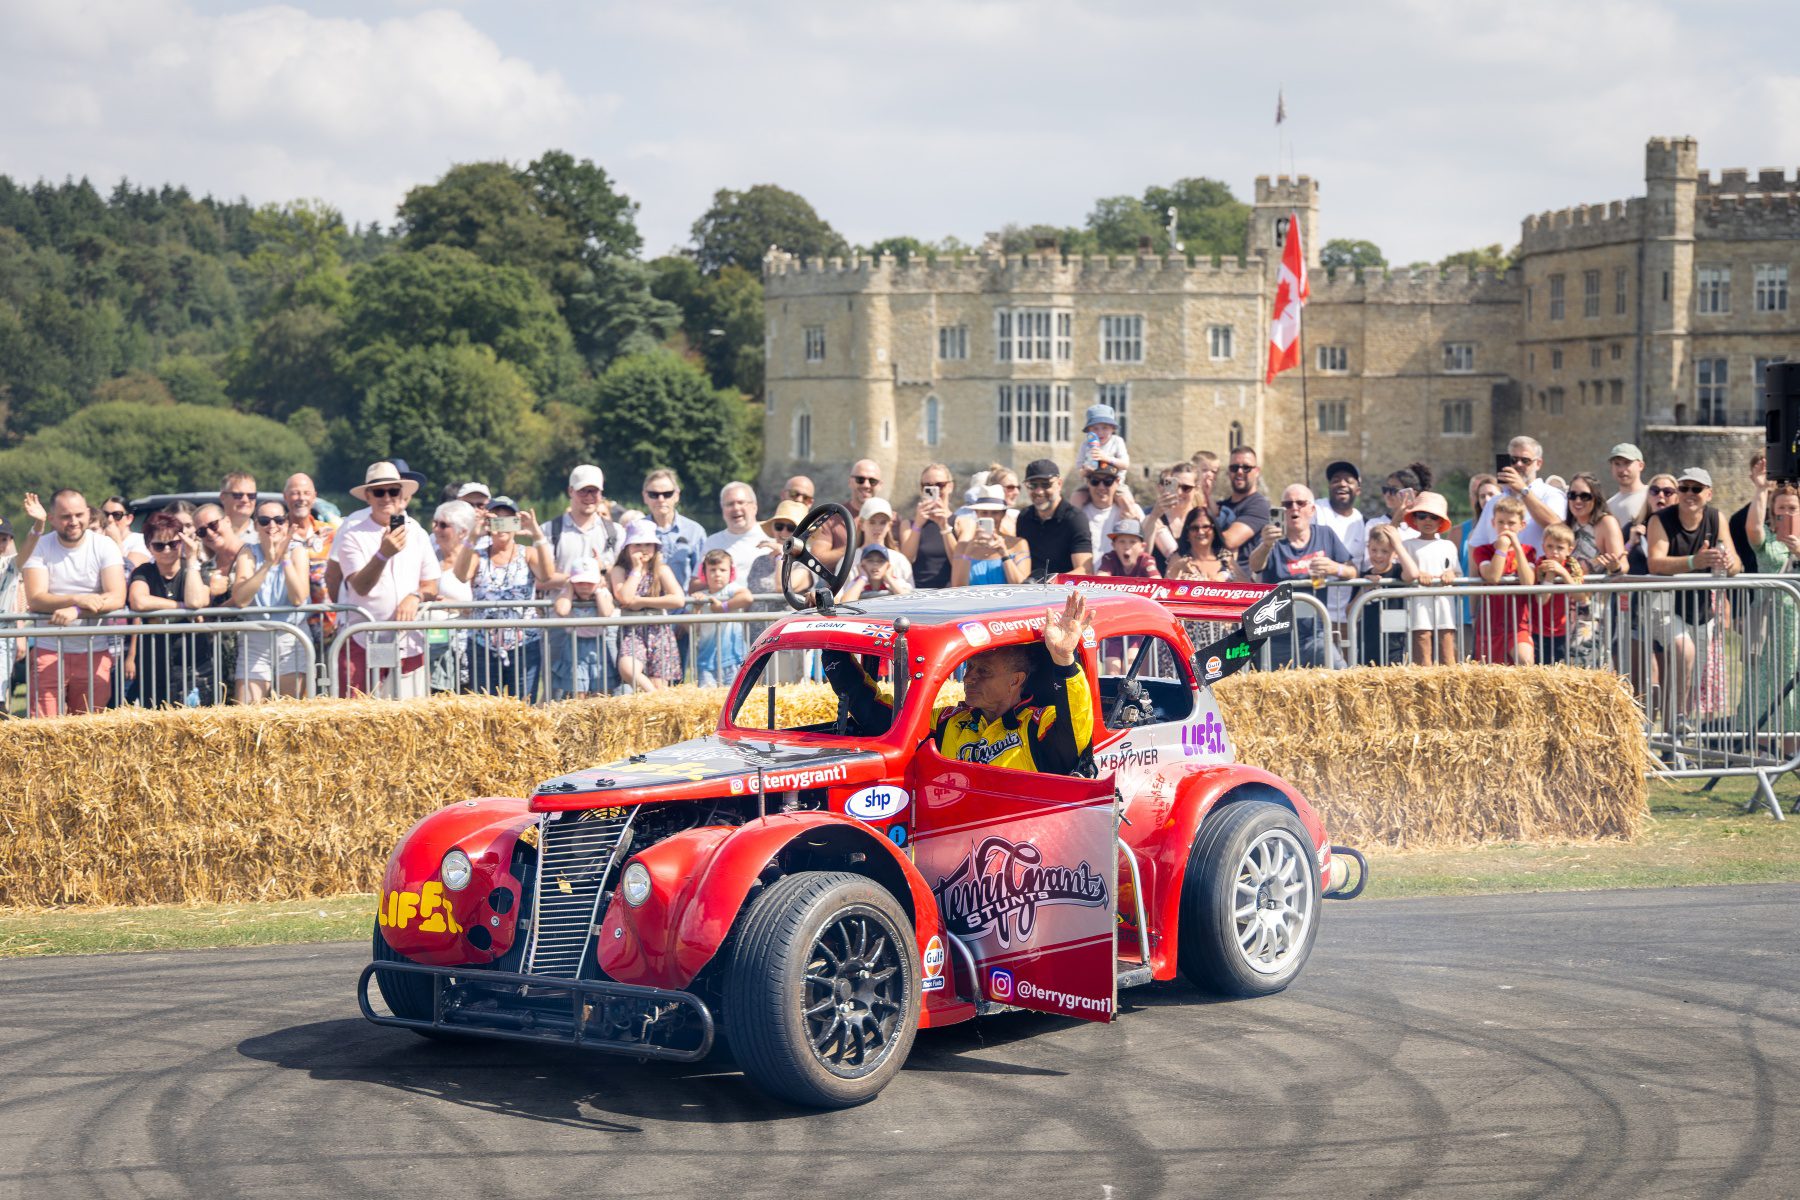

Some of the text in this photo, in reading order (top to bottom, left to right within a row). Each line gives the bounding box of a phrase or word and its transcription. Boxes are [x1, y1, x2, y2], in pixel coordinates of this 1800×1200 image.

[1190, 585, 1271, 599] @terrygrant
[1253, 621, 1290, 635] alpinestars
[1207, 661, 1221, 669] Gulf
[748, 764, 847, 793] @terrygrant1
[864, 789, 891, 810] shp
[966, 891, 1049, 929] STUNTS
[926, 950, 943, 963] Gulf
[1017, 980, 1111, 1013] @terrygrant1
